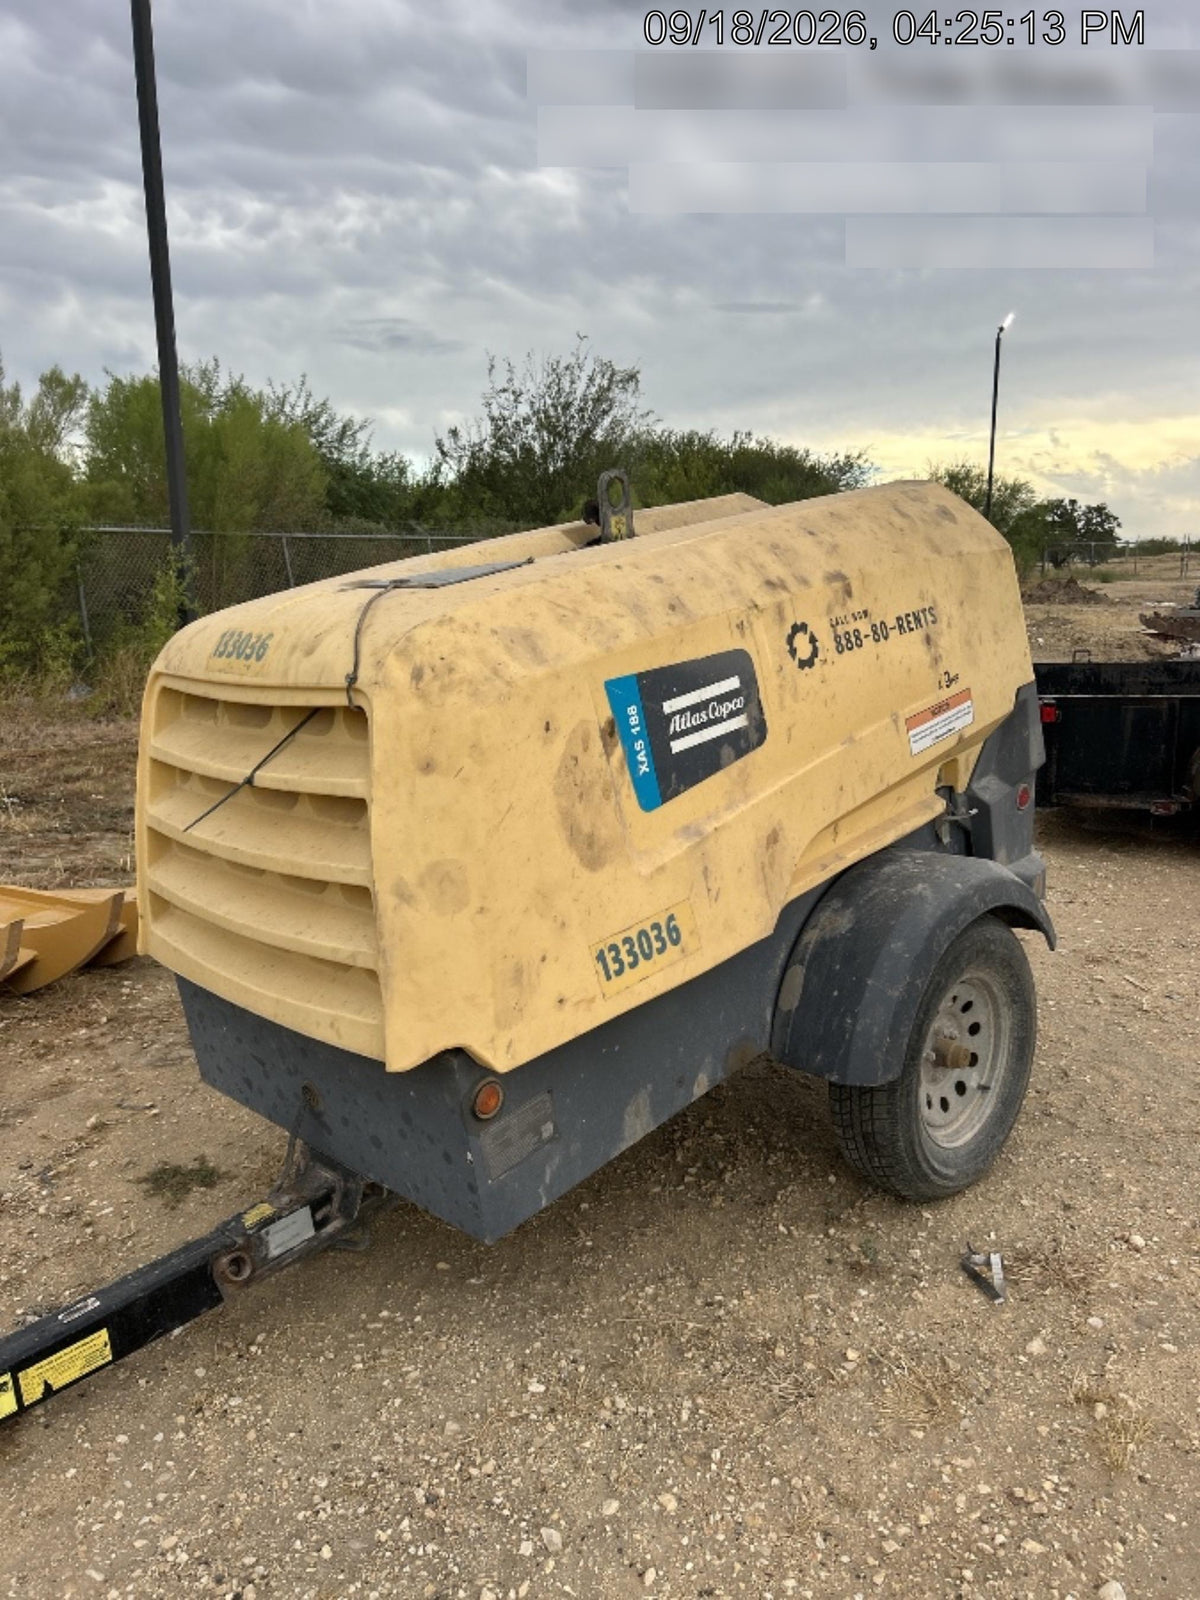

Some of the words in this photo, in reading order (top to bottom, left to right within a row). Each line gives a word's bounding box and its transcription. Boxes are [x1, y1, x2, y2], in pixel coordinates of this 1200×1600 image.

[213, 628, 274, 663] 133036
[834, 606, 938, 655] 888-80-RENTS
[627, 704, 641, 735] 188
[669, 708, 708, 735] Atlas
[708, 696, 745, 719] Copco
[634, 739, 650, 776] XAS
[595, 913, 682, 982] 133036
